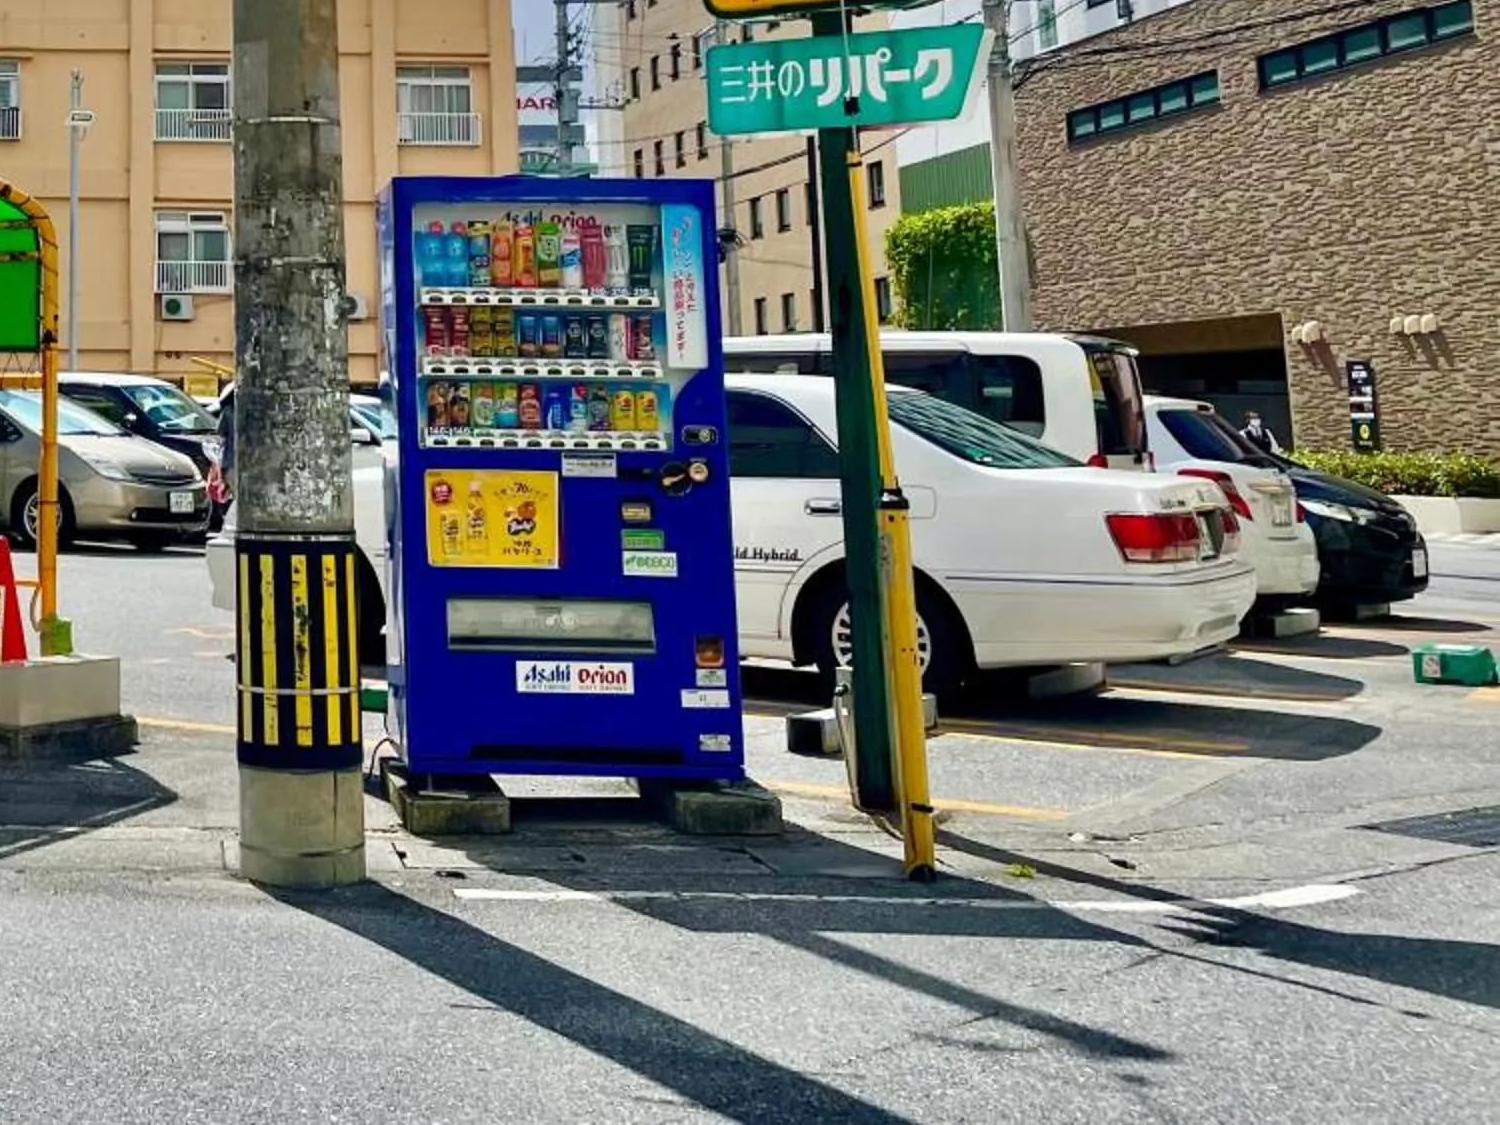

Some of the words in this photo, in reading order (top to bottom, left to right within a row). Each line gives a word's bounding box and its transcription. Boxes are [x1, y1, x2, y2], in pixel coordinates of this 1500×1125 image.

[720, 47, 953, 107] 三井のリパーク
[753, 547, 799, 563] Hybrid
[524, 663, 571, 683] Asahi
[578, 664, 627, 684] Orion
